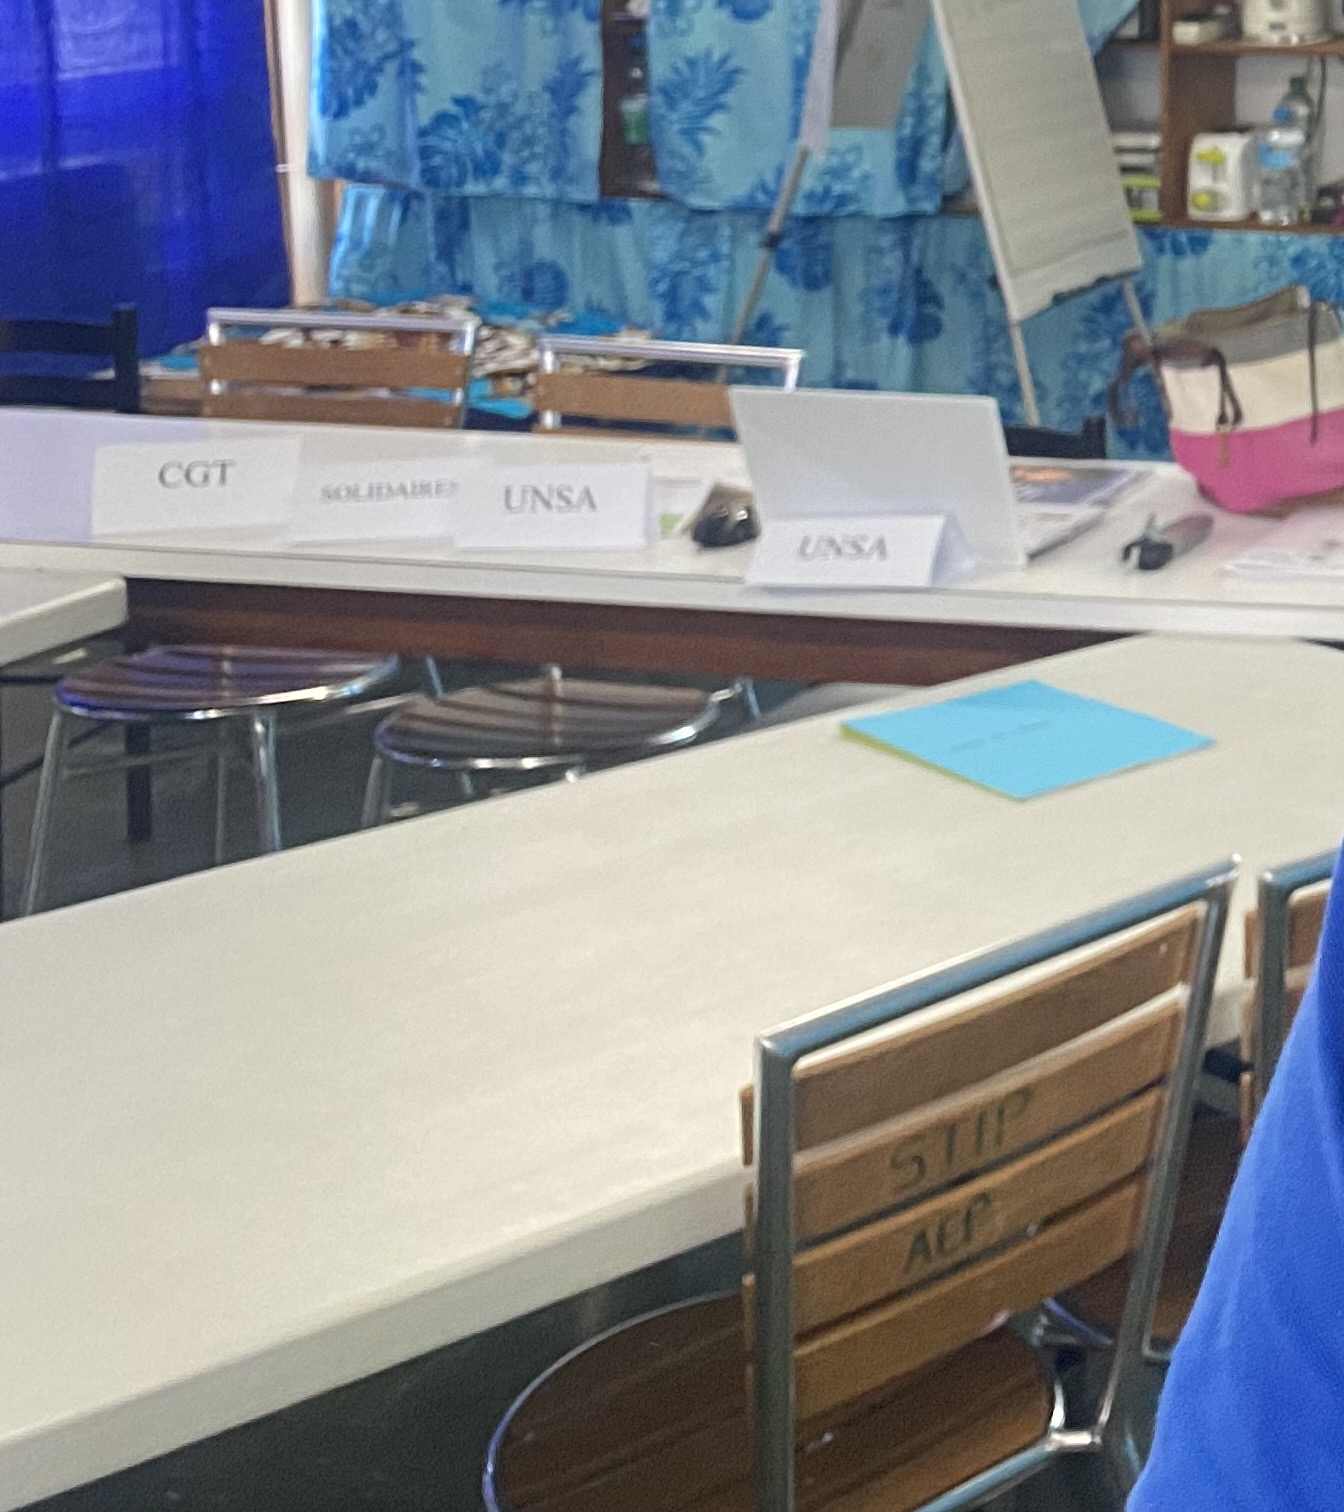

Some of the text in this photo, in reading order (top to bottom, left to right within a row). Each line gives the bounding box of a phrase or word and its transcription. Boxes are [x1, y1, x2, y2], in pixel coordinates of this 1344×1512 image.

[157, 458, 234, 488] CGT
[503, 483, 598, 513] UNSA
[798, 534, 889, 563] UNSA
